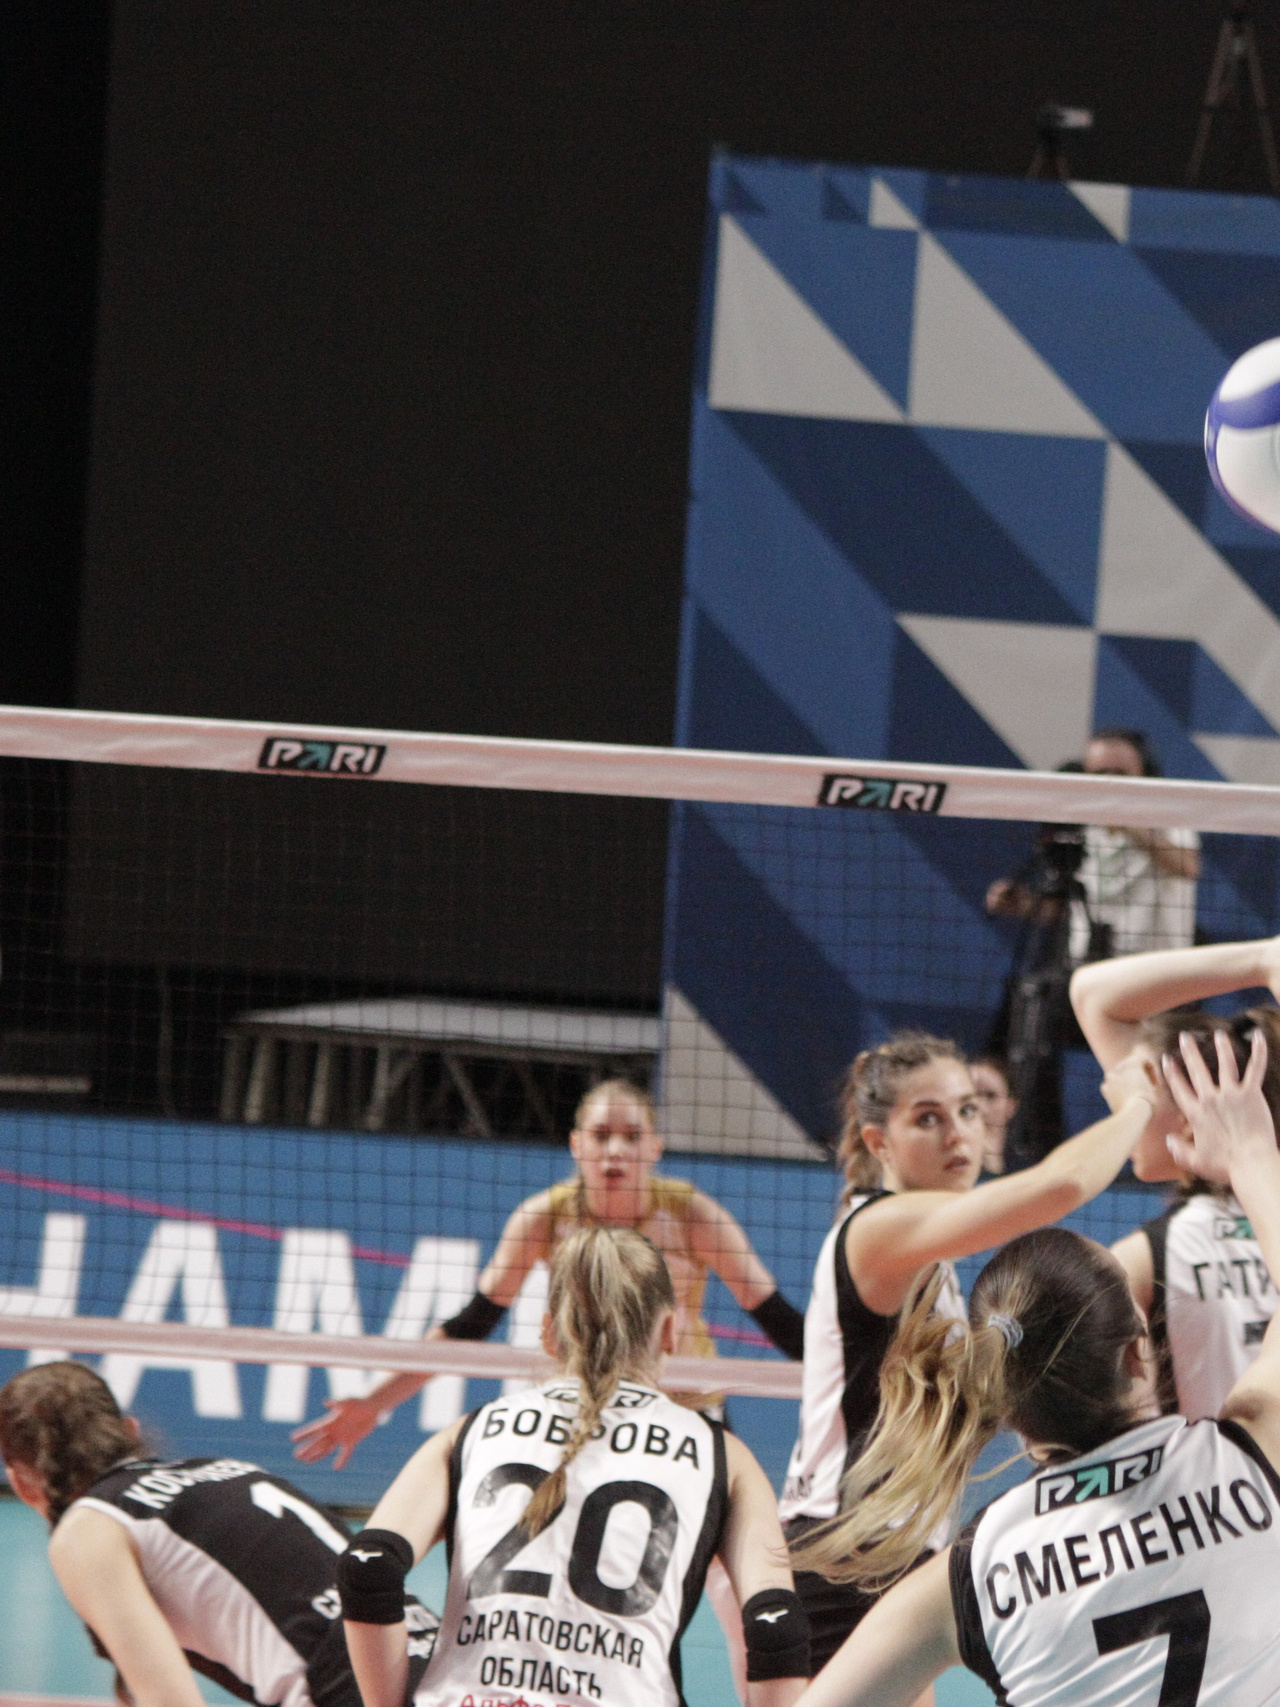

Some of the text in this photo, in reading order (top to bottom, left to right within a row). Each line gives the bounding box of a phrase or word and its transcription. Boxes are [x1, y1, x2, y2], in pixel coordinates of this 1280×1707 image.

[266, 740, 379, 774] PARI
[826, 777, 938, 812] PARI
[1039, 1449, 1162, 1513] PARI
[467, 1462, 679, 1618] 20
[985, 1479, 1273, 1620] СМЕЛЕНКО
[456, 1610, 645, 1669] САРАТОВСКАЯ
[1091, 1589, 1212, 1707] 7
[480, 1655, 603, 1699] ОБЛАСТЬ
